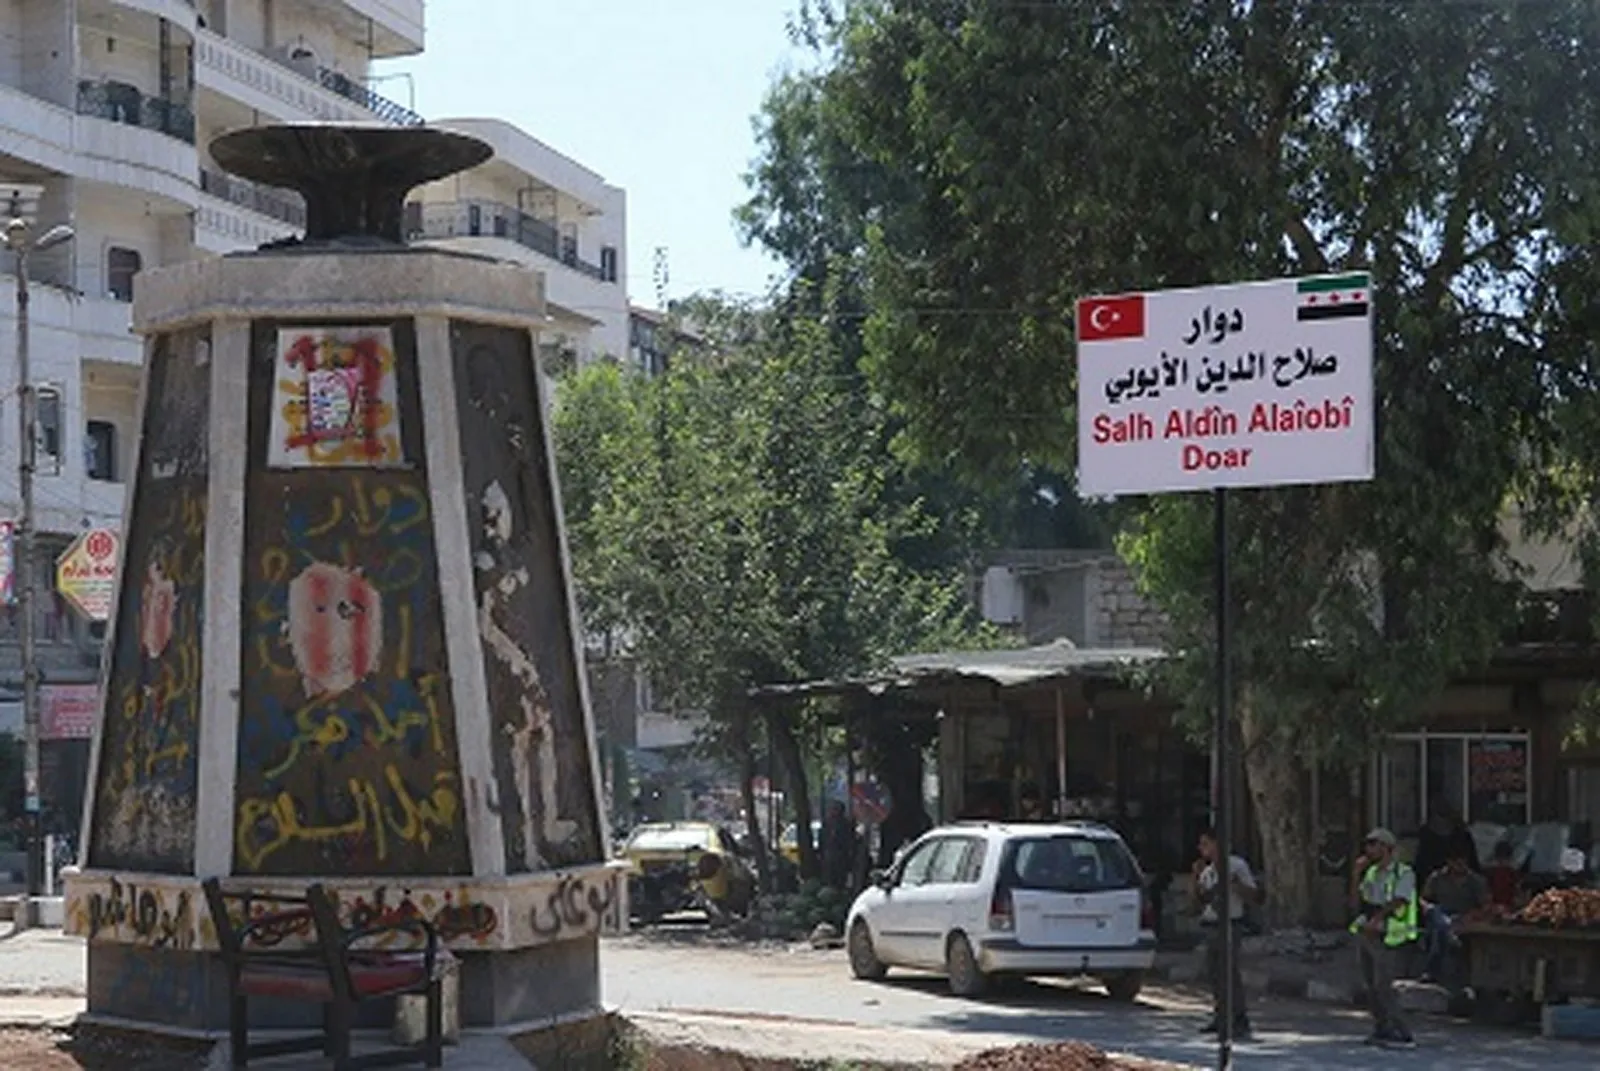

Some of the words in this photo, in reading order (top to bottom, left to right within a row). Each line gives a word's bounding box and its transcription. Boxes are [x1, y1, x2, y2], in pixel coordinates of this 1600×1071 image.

[1182, 305, 1244, 344] دوار
[1104, 350, 1188, 403] الأيوبي
[1195, 351, 1265, 392] الدين
[1272, 347, 1338, 387] صلاح
[1092, 409, 1153, 444] Salh
[1163, 404, 1237, 438] Aldîn
[1248, 395, 1355, 433] Alaîobî
[1182, 444, 1252, 471] Doar
